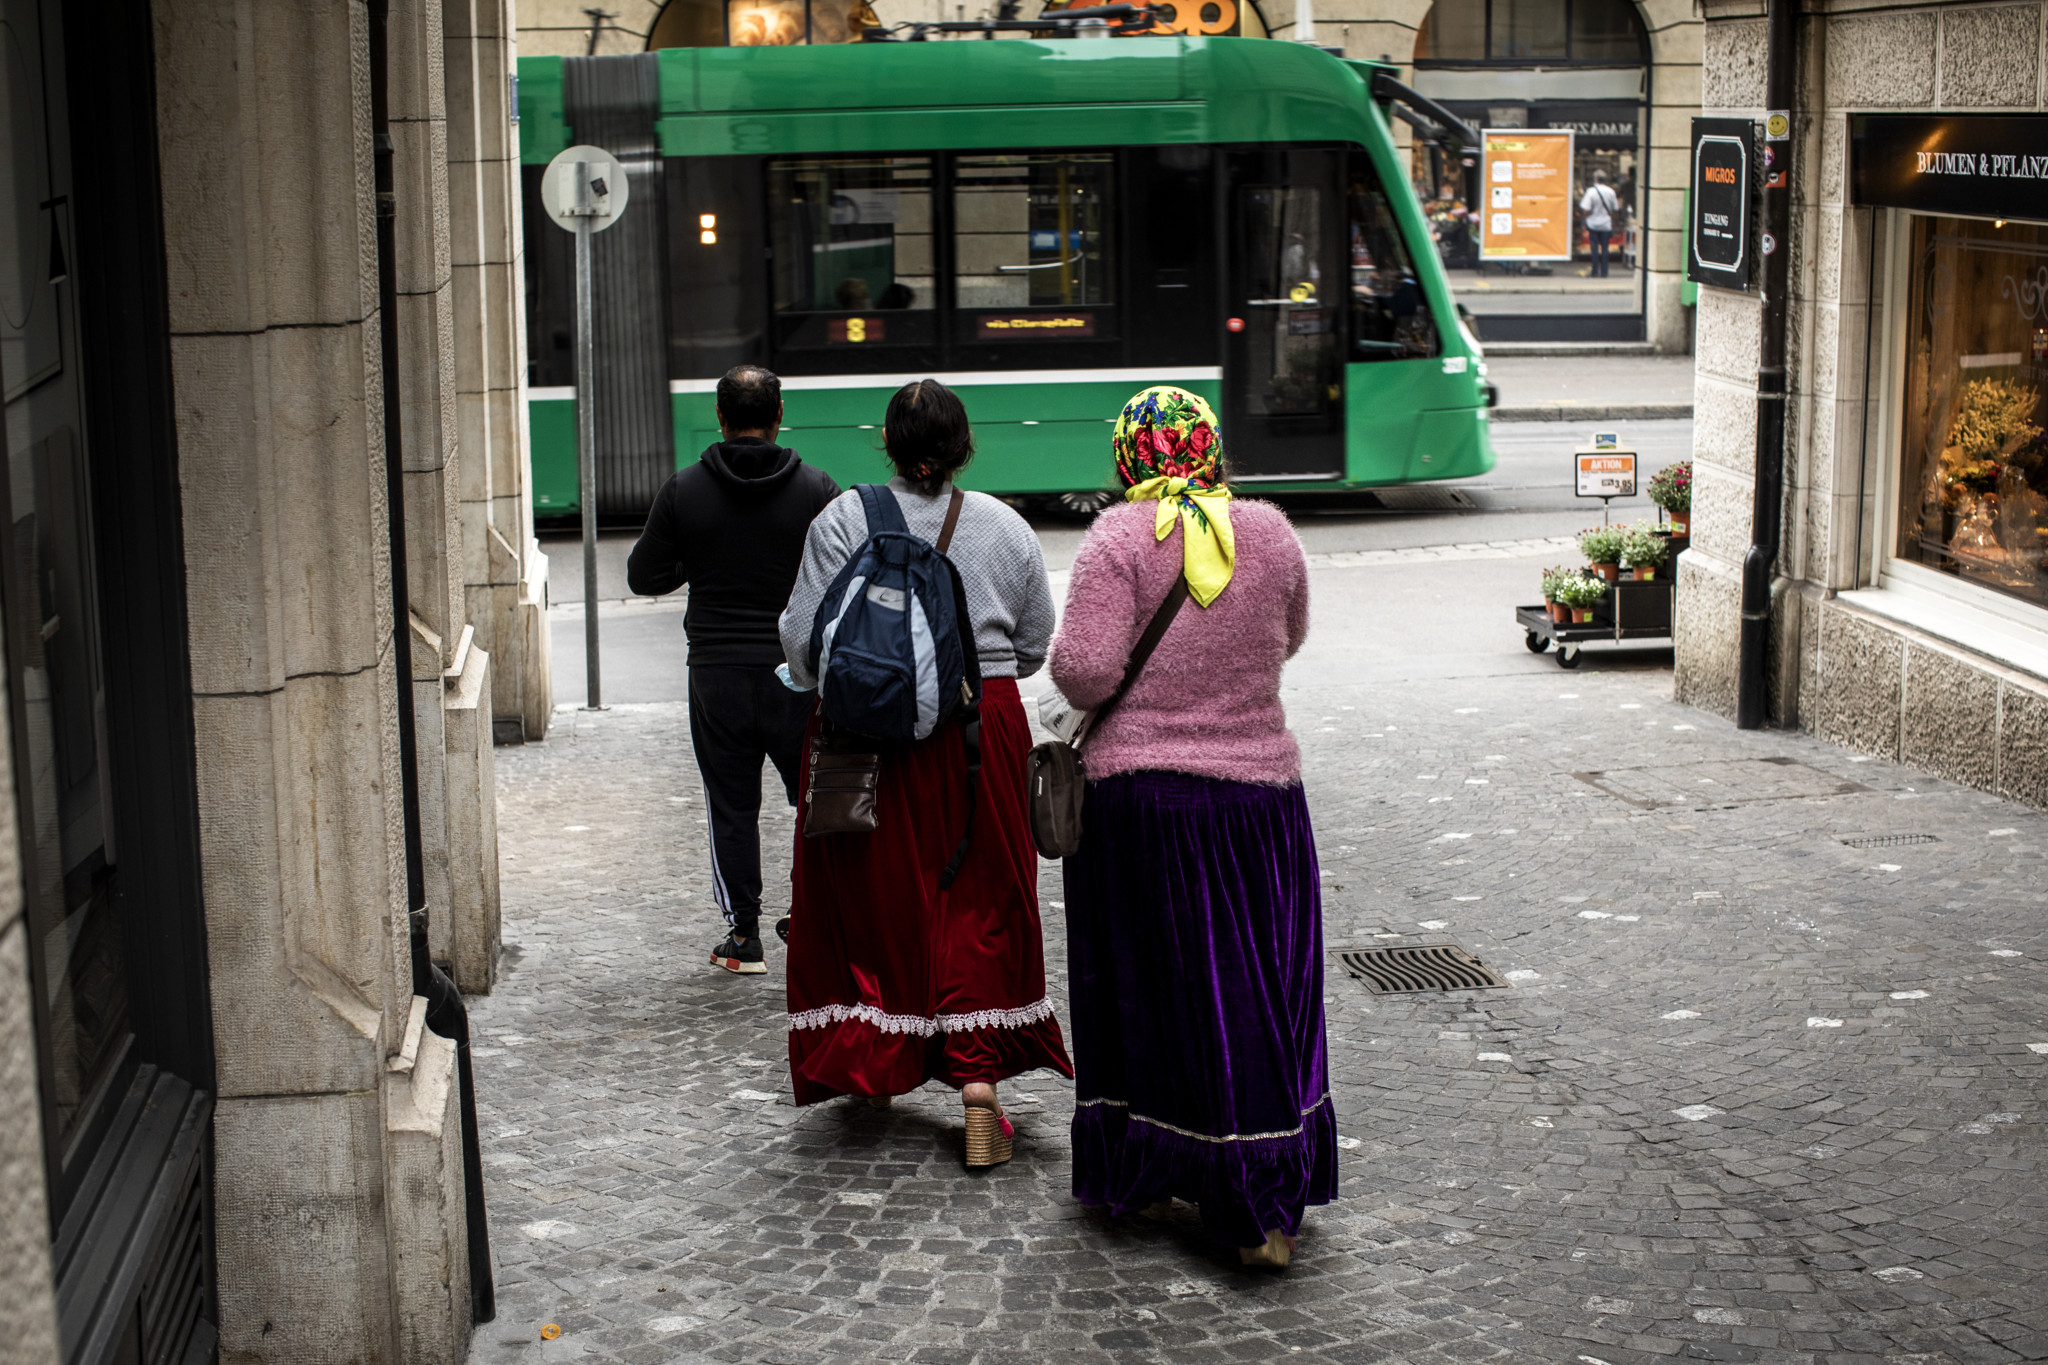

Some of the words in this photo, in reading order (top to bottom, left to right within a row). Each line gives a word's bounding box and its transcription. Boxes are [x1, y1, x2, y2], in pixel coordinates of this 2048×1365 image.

[1705, 166, 1736, 185] MIGROS
[1916, 151, 1977, 176] BLUMEN
[1979, 152, 1990, 177] &
[1991, 153, 2048, 180] PFLANZ
[846, 317, 866, 342] 8
[1590, 459, 1622, 470] AKTION
